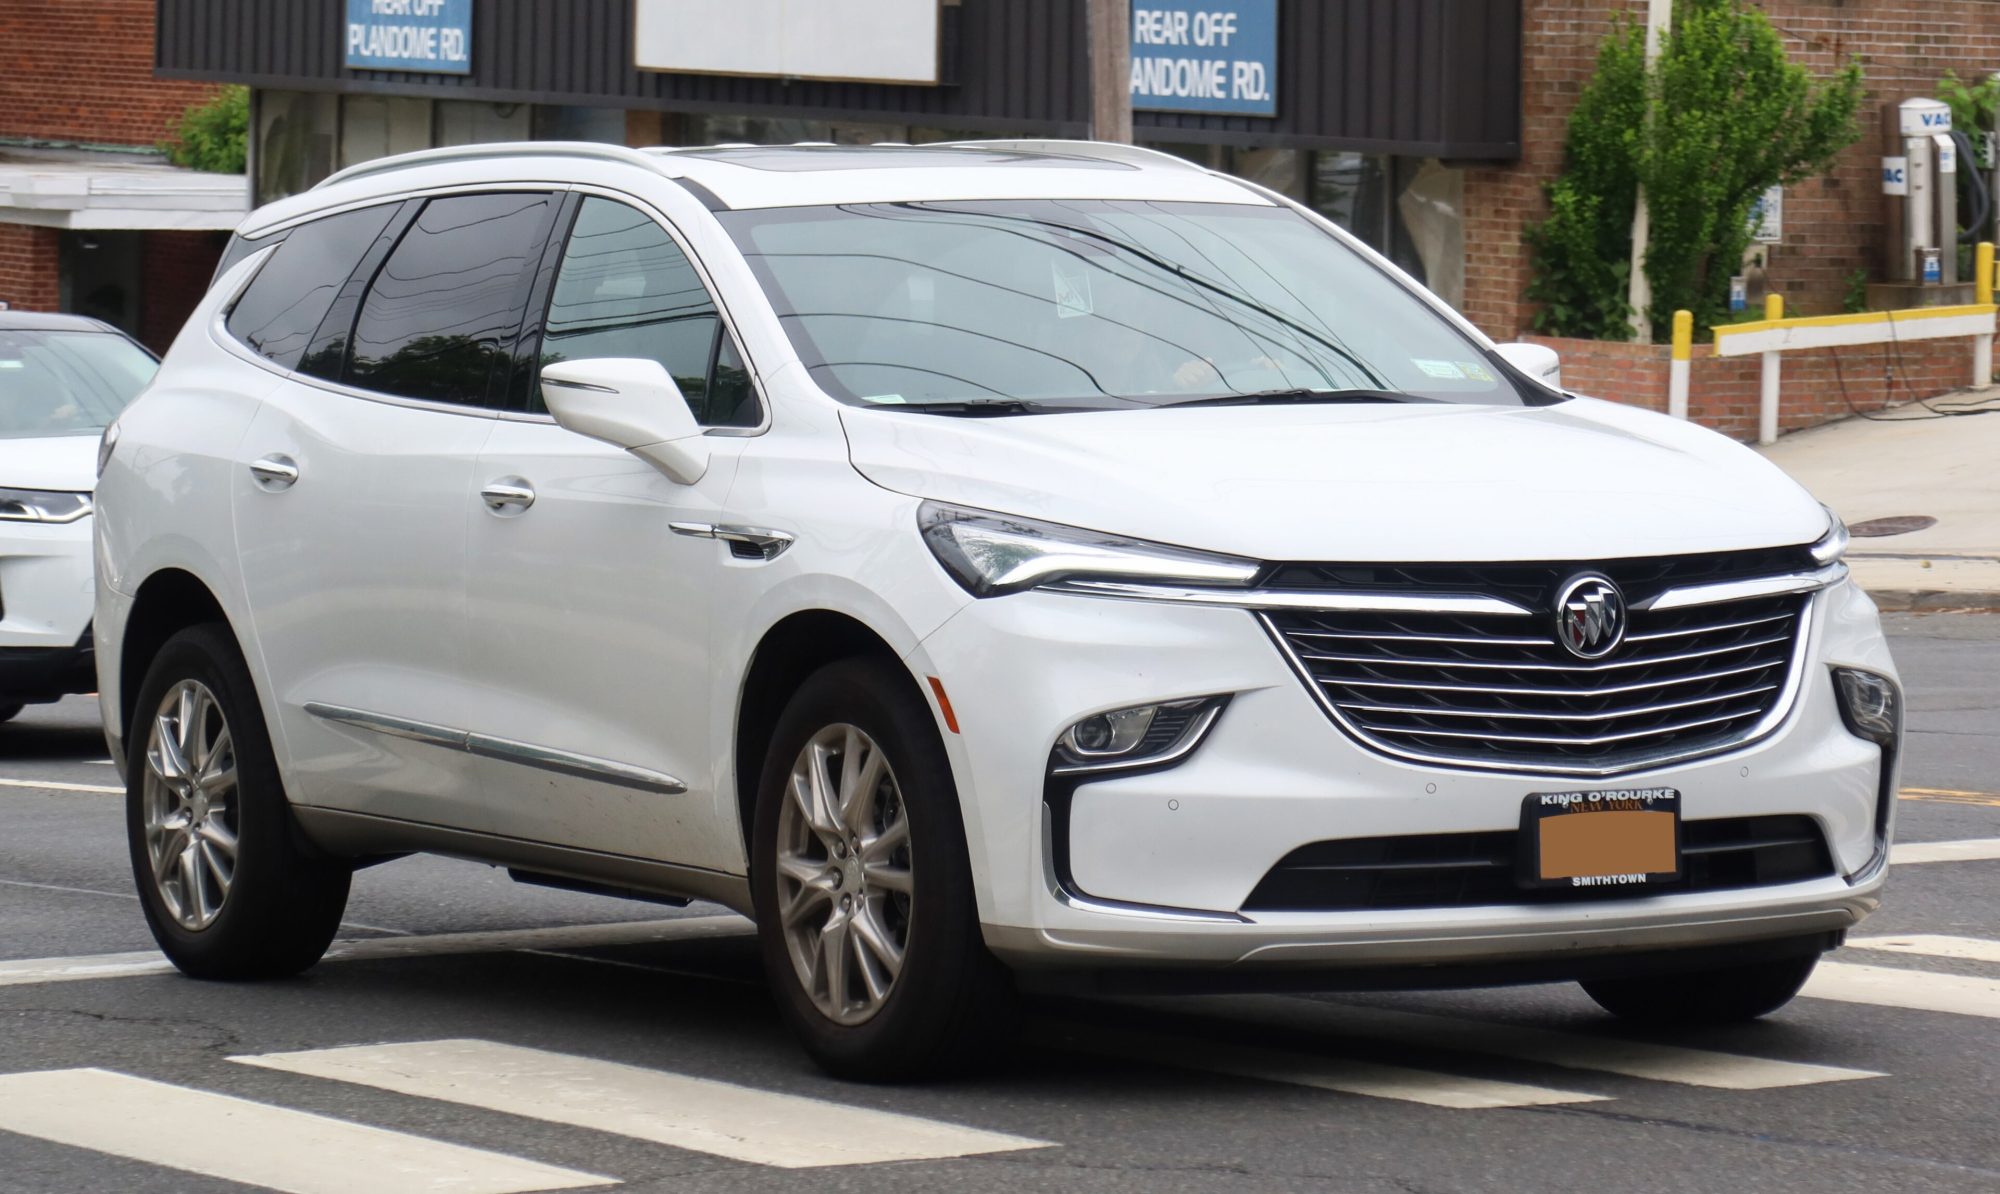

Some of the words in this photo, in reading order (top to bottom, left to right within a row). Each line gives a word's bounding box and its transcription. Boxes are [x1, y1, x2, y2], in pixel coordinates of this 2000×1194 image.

[1134, 10, 1189, 46] REAR
[1193, 11, 1238, 47] OFF
[348, 23, 437, 60] PLANDOME
[440, 27, 467, 61] RD.
[1232, 61, 1270, 101] RD.
[1541, 793, 1583, 805] KING
[1588, 789, 1675, 802] O'ROURKE
[1608, 799, 1644, 811] YORK
[1572, 873, 1647, 887] SMITHTOWN
